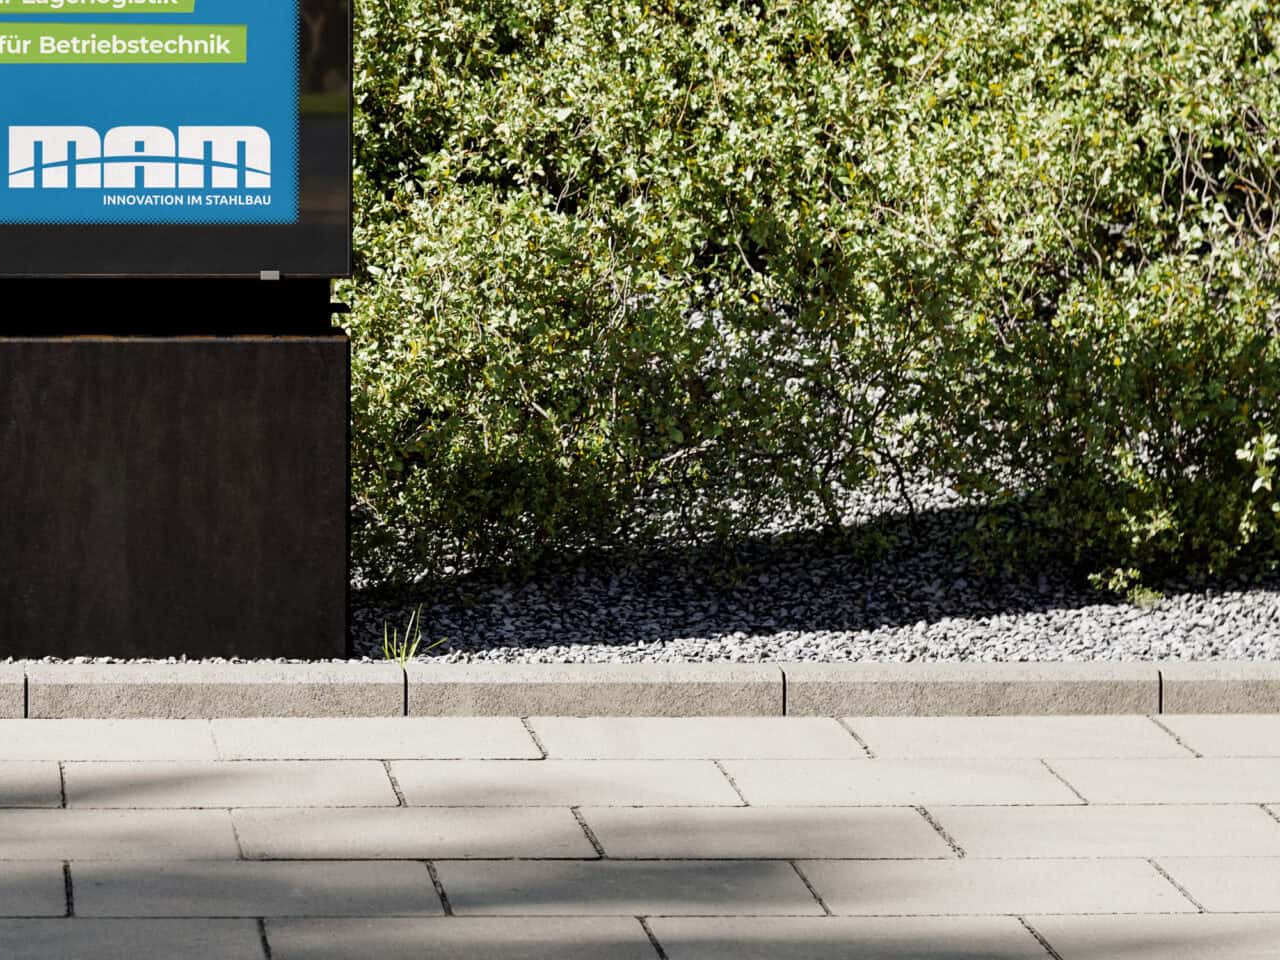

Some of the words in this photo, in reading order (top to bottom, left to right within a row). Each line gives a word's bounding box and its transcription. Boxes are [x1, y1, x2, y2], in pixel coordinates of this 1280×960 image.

[39, 33, 231, 56] Betriebstechnik
[104, 195, 183, 206] INNOVATION
[188, 195, 202, 206] IM
[205, 195, 271, 206] STAHLBAU
